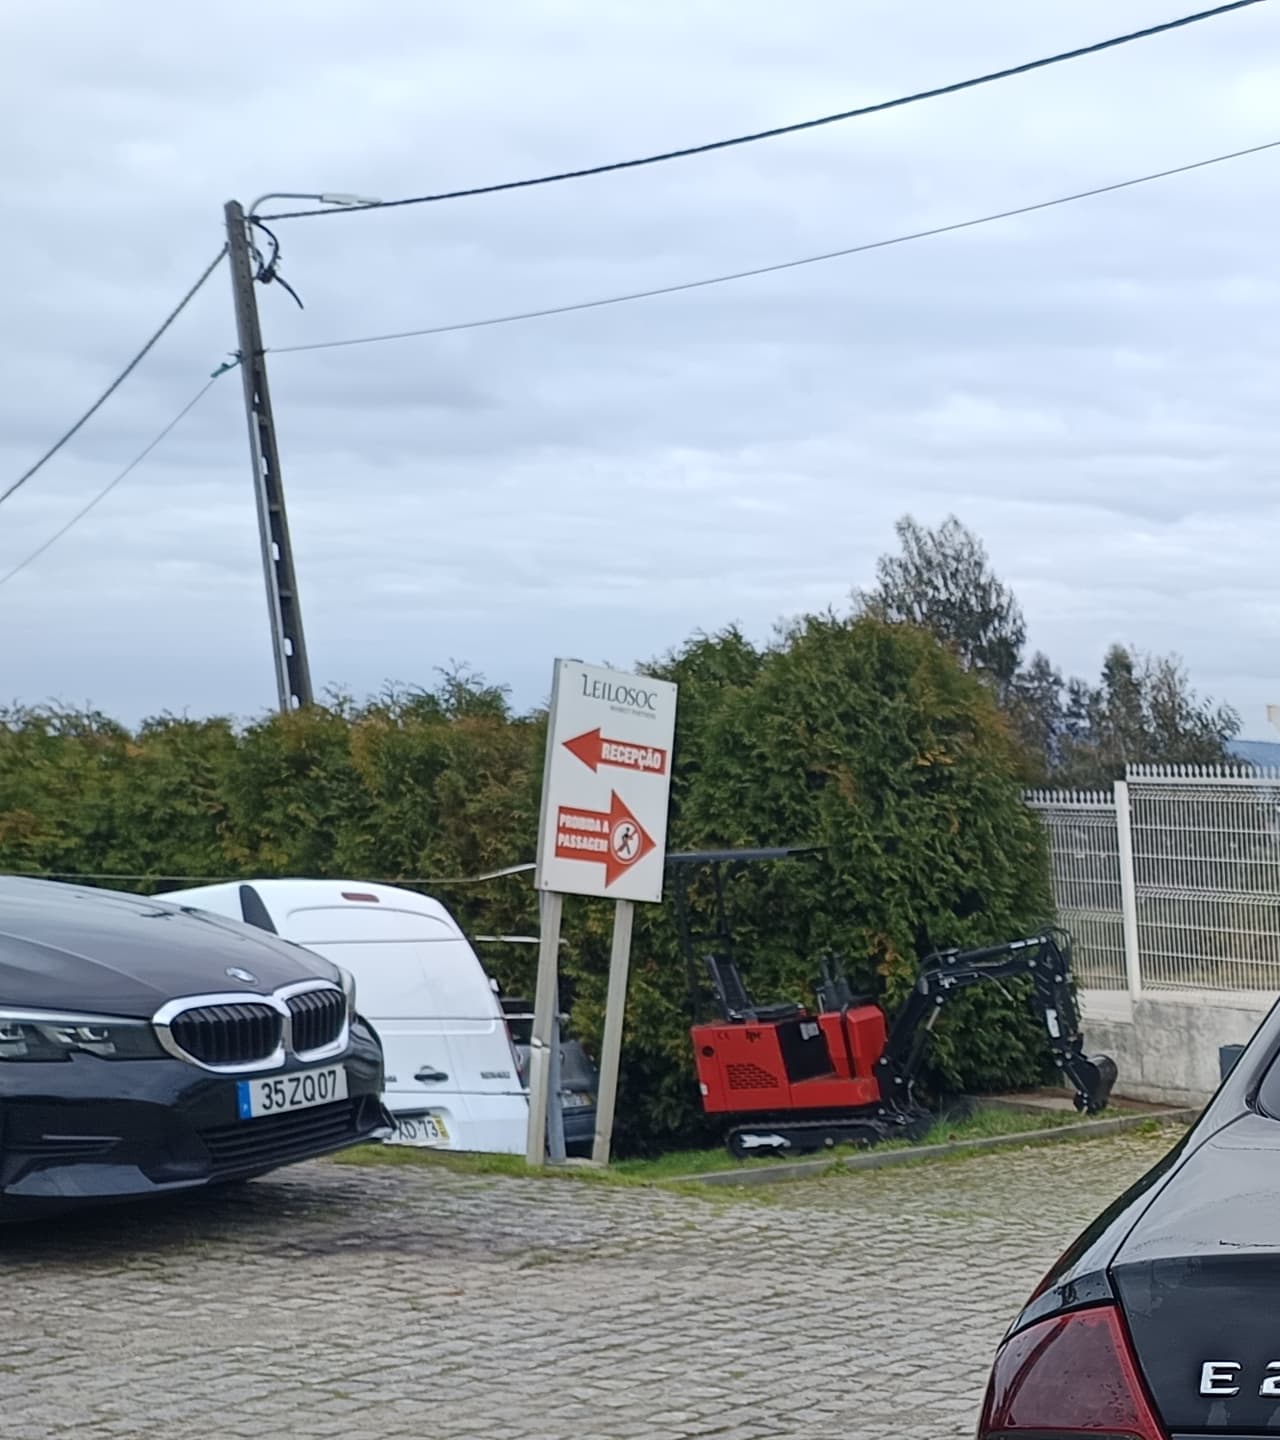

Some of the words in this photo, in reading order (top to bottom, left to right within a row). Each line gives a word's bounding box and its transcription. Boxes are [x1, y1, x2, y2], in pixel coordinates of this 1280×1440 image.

[581, 673, 658, 711] LEILOSOC
[260, 1069, 337, 1111] 35ZQ07
[1200, 1361, 1242, 1396] E
